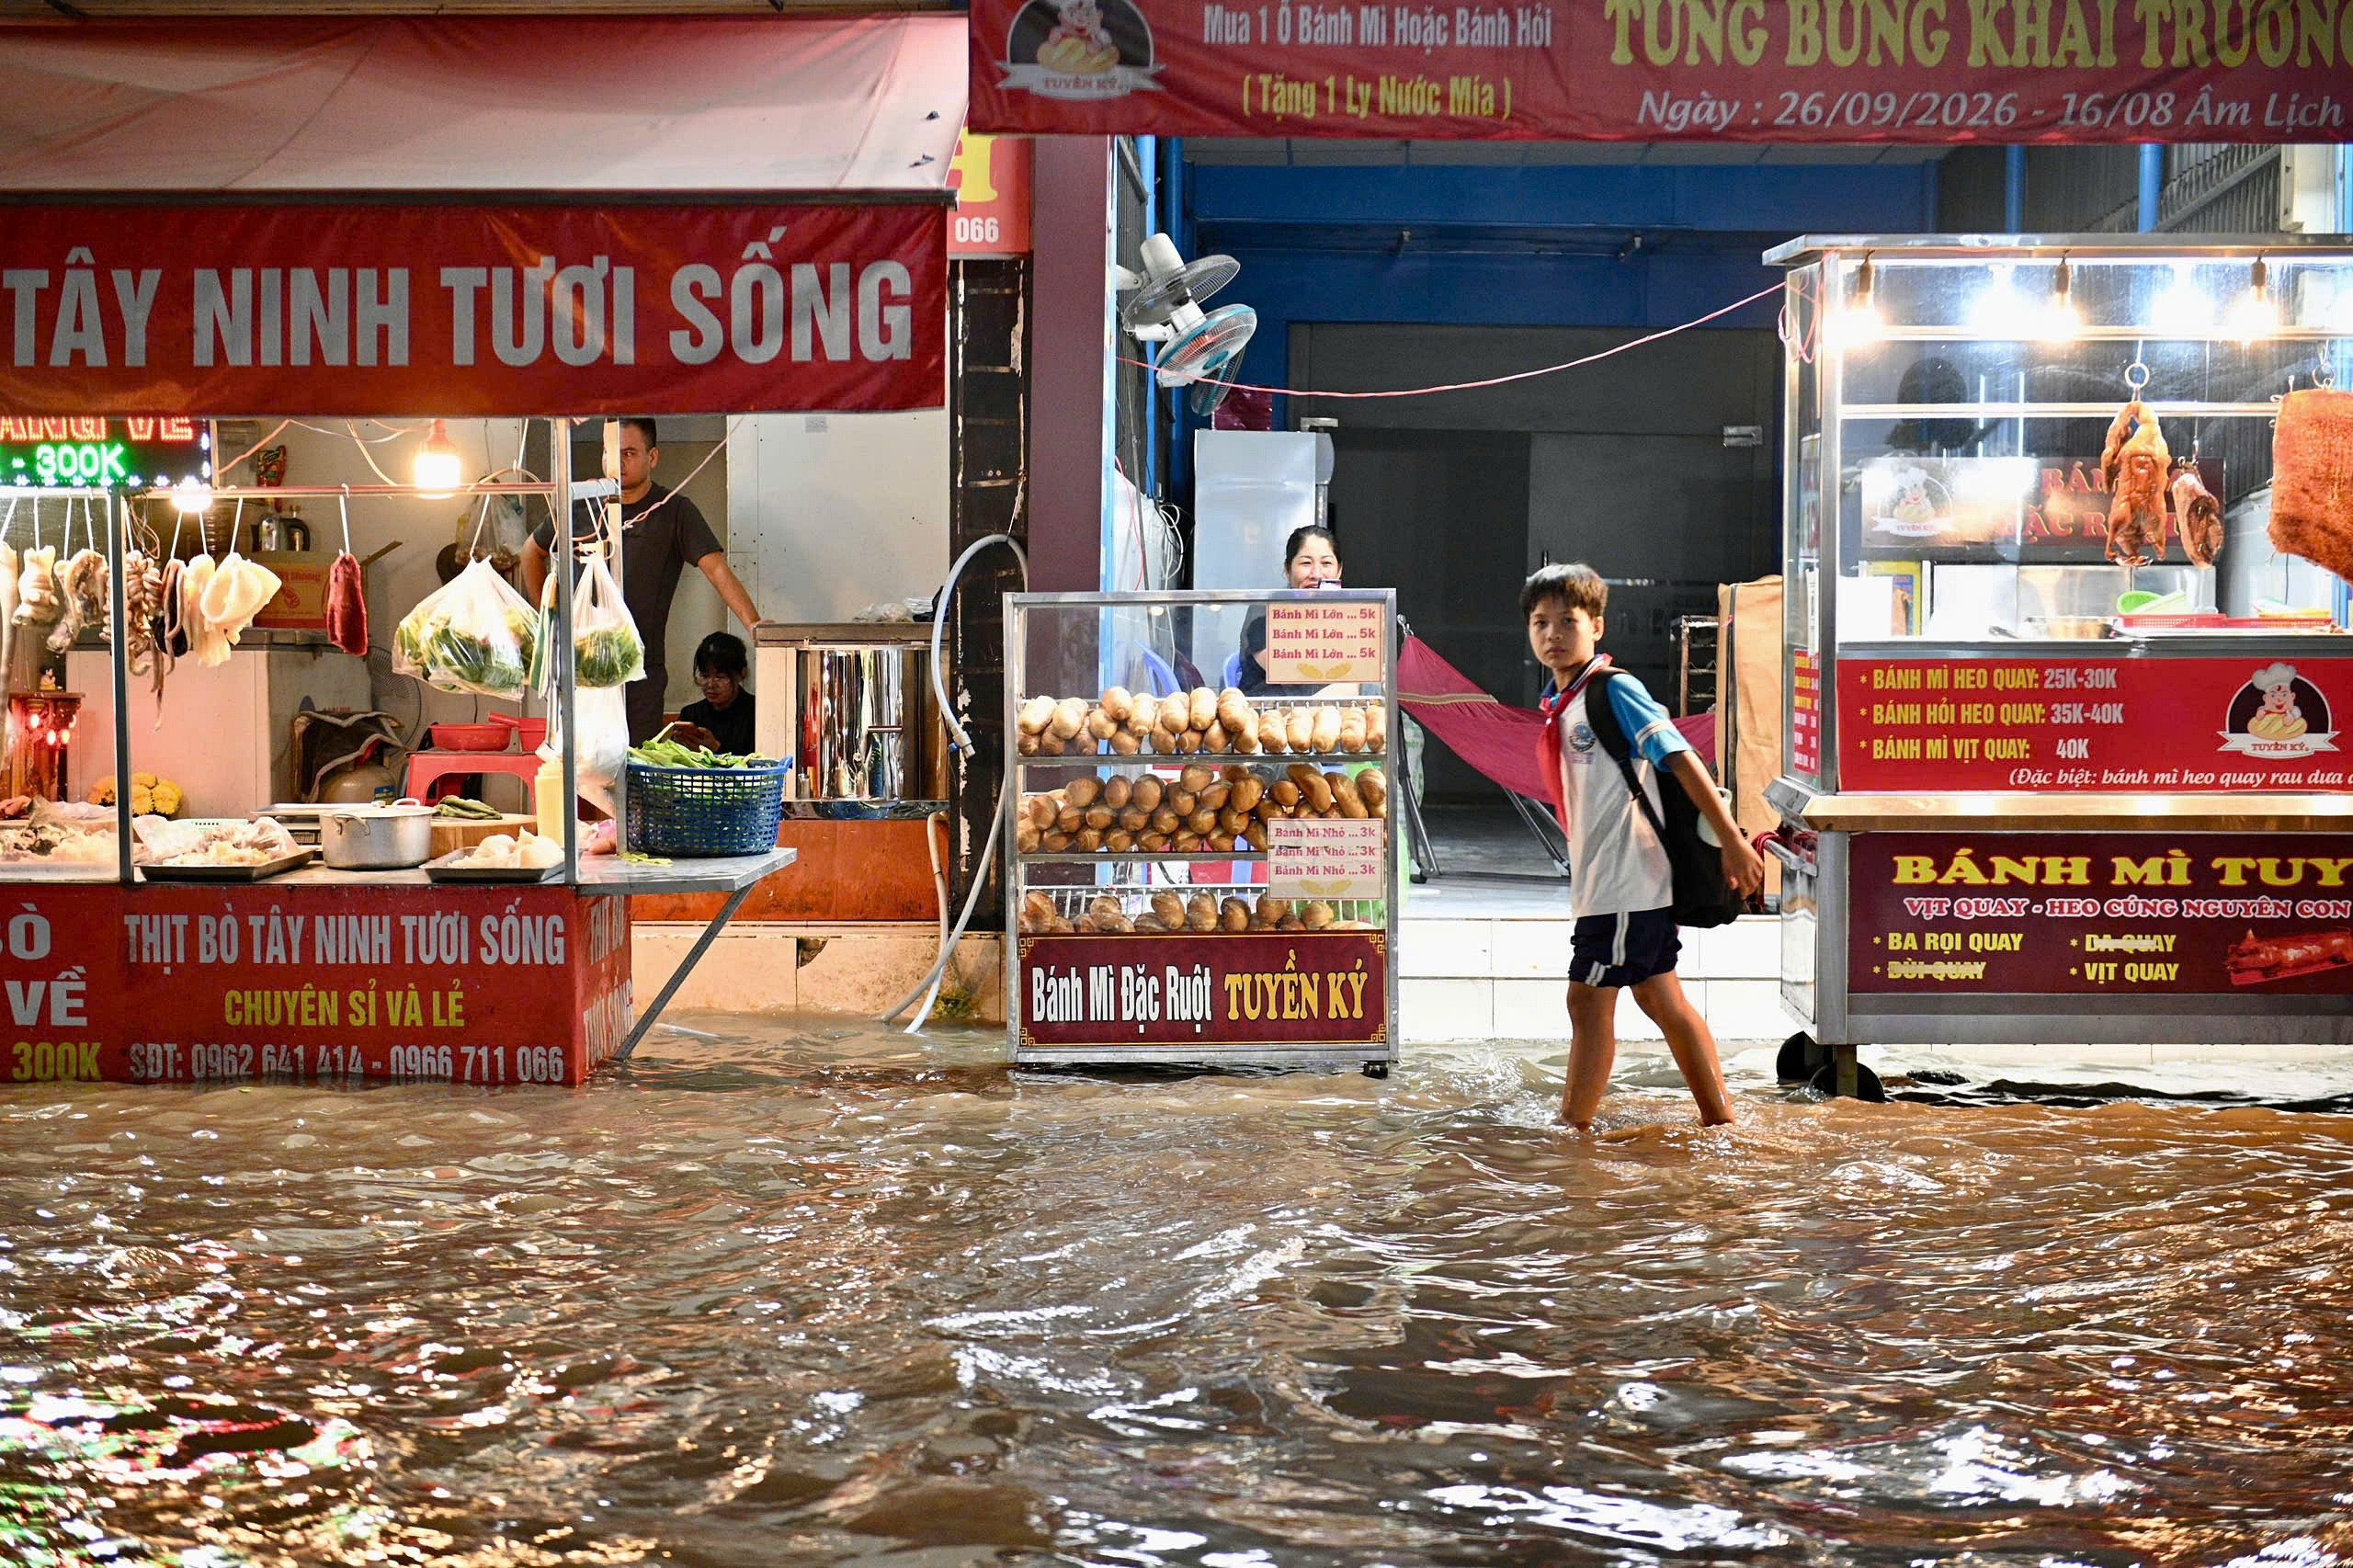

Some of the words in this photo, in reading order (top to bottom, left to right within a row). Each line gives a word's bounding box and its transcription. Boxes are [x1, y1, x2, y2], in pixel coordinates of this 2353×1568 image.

[1203, 5, 1251, 44] Mua
[1258, 5, 1268, 44] 1
[1299, 4, 1353, 44] Bánh
[1394, 5, 1449, 55] Hoặc
[1456, 6, 1510, 45] Bánh
[1517, 2, 1552, 47] Hỏi
[1967, 0, 2117, 67] KHAI
[1258, 74, 1316, 121] Tặng
[1324, 74, 1336, 113] 1
[1346, 74, 1371, 119] Ly
[1379, 74, 1441, 116] Nước
[1449, 74, 1495, 116] Mía
[1637, 90, 1741, 133] Ngày
[1773, 90, 2018, 128] 26/09/2026
[2057, 91, 2177, 128] 16/08
[2185, 84, 2251, 126] Âm
[2264, 92, 2344, 133] Lịch
[955, 217, 999, 243] 066
[2, 246, 163, 367] TÂY
[193, 267, 409, 367] NINH
[439, 255, 635, 366] TƯƠI
[668, 225, 912, 364] SỐNG
[36, 444, 125, 477] 300K
[1272, 609, 1302, 619] Bánh
[1323, 609, 1344, 619] Lớn
[1359, 608, 1376, 619] 5k
[1272, 629, 1302, 639] Bánh
[1323, 629, 1344, 639] Lớn
[1359, 628, 1376, 639] 5k
[1272, 649, 1302, 659] Bánh
[1323, 649, 1344, 659] Lớn
[1359, 647, 1376, 659] 5k
[1873, 665, 1921, 689] BÁNH
[1927, 665, 1949, 689] MÌ
[1954, 669, 1988, 689] HEO
[1994, 669, 2039, 690] QUAY:
[2044, 668, 2117, 689] 25K-30K
[1873, 700, 1921, 724] BÁNH
[1927, 698, 1955, 724] HỎI
[1961, 704, 1995, 724] HEO
[2000, 704, 2045, 725] QUAY:
[2051, 703, 2123, 724] 35K-40K
[1873, 735, 1921, 759] BÁNH
[1927, 734, 1948, 759] MÌ
[1953, 739, 1980, 764] VỊT
[1984, 739, 2029, 761] QUAY:
[2055, 739, 2089, 759] 40K
[2009, 768, 2052, 787] (Đặc
[2056, 769, 2097, 787] biệt:
[2102, 769, 2149, 784] bánh
[2154, 769, 2178, 784] mì
[2182, 769, 2215, 784] heo
[2220, 772, 2267, 787] quay
[2270, 772, 2302, 784] rau
[2307, 769, 2343, 784] dưa
[1275, 828, 1302, 837] Bánh
[1323, 827, 1346, 837] Nhỏ
[1360, 827, 1376, 837] 3k
[1360, 846, 1376, 857] 3k
[1893, 847, 2092, 885] BÁNH
[2110, 848, 2192, 885] MÌ
[2211, 857, 2353, 886] TUY
[1275, 866, 1302, 875] Bánh
[1323, 865, 1346, 875] Nhỏ
[1360, 865, 1376, 875] 3k
[1904, 897, 1950, 920] VỊT
[1954, 897, 2029, 920] QUAY
[2046, 898, 2100, 917] HEO
[2104, 894, 2178, 917] CÚNG
[2183, 895, 2290, 918] NGUYÊN
[2296, 900, 2351, 918] CON
[0, 903, 51, 960] Ò
[124, 914, 188, 975] THỊT
[199, 903, 239, 964] BÒ
[248, 904, 304, 964] TÂY
[314, 915, 391, 964] NINH
[401, 911, 469, 964] TƯƠI
[480, 897, 564, 965] SỐNG
[1888, 933, 1918, 950] BA
[1925, 933, 1961, 954] RỌI
[1969, 933, 2023, 952] QUAY
[2085, 963, 2118, 984] VỊT
[2124, 963, 2179, 983] QUAY
[5, 966, 87, 1026] VỀ
[224, 983, 338, 1027] CHUYÊN
[348, 978, 377, 1027] SỈ
[385, 983, 424, 1027] VÀ
[432, 979, 465, 1027] LẺ
[1032, 965, 1083, 1022] Bánh
[1090, 964, 1115, 1021] Mì
[1120, 963, 1160, 1033] Đặc
[1166, 963, 1212, 1033] Ruột
[1223, 949, 1320, 1020] TUYỀN
[1327, 958, 1369, 1020] KÝ
[12, 1041, 101, 1082] 300K
[130, 1043, 183, 1079] SĐT:
[191, 1043, 254, 1078] 0962
[261, 1044, 304, 1074] 641
[316, 1045, 364, 1074] 414
[390, 1045, 453, 1075] 0966
[460, 1046, 505, 1082] 711
[517, 1046, 564, 1082] 066
